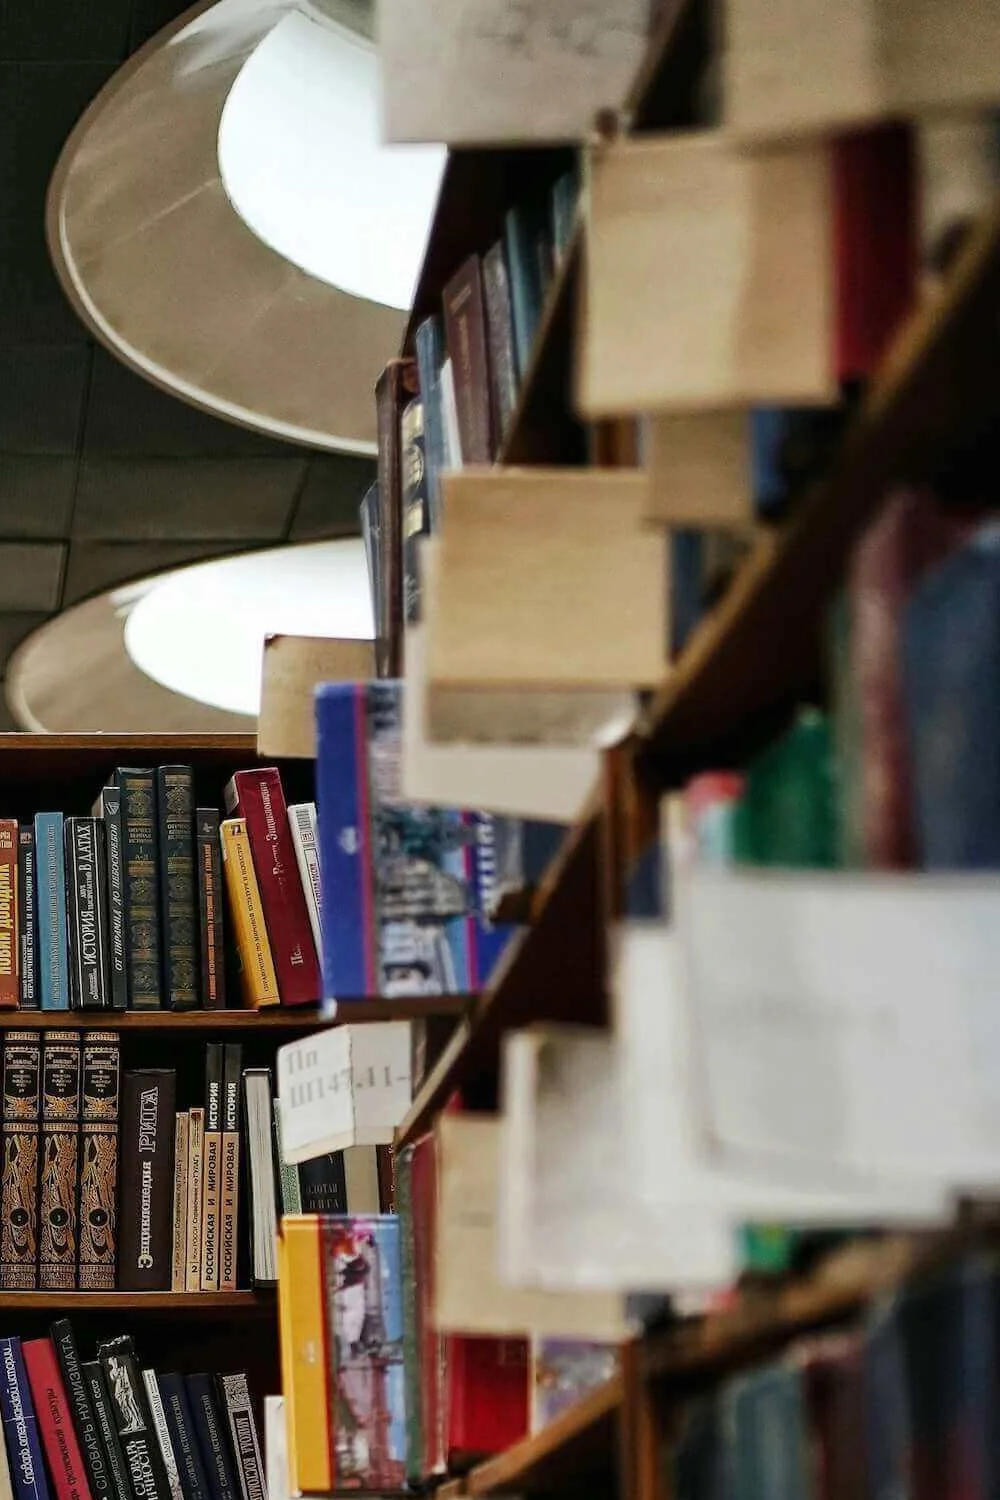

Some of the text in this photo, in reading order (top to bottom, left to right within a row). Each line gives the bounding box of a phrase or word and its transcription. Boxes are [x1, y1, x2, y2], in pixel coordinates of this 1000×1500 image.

[24, 852, 32, 874] МИРА
[77, 825, 92, 862] ДАТАХ
[110, 823, 122, 971] ОТ ПИРАМИД ДО НЕБОСКРЕБОВ
[80, 910, 97, 965] ИСТОРИЯ
[227, 1082, 236, 1130] ИСТОРИЯ
[137, 1086, 158, 1269] Энциклопедия РИГА
[205, 1082, 219, 1281] РОССИЙСКАЯ И МИРОВАЯ ИСТОРИЯ
[226, 1142, 235, 1192] МИРОВАЯ
[222, 1214, 233, 1282] РОССИЙСКАЯ
[2, 1345, 18, 1385] истории
[90, 1379, 102, 1398] СССР
[60, 1334, 107, 1490] СЛОВАРЬ НУМИЗМАТА
[97, 1400, 113, 1440] НАЗВАНИЙ
[236, 1418, 253, 1453] МИКОЛА
[171, 1394, 199, 1487] СЛОВАРЬ ИСТОРИЧЕСКИЙ
[201, 1394, 228, 1487] СЛОВАРЬ ИСТОРИЧЕСКИЙ
[18, 1450, 35, 1484] Словарь
[125, 1440, 146, 1496] СЛОВАРЬ
